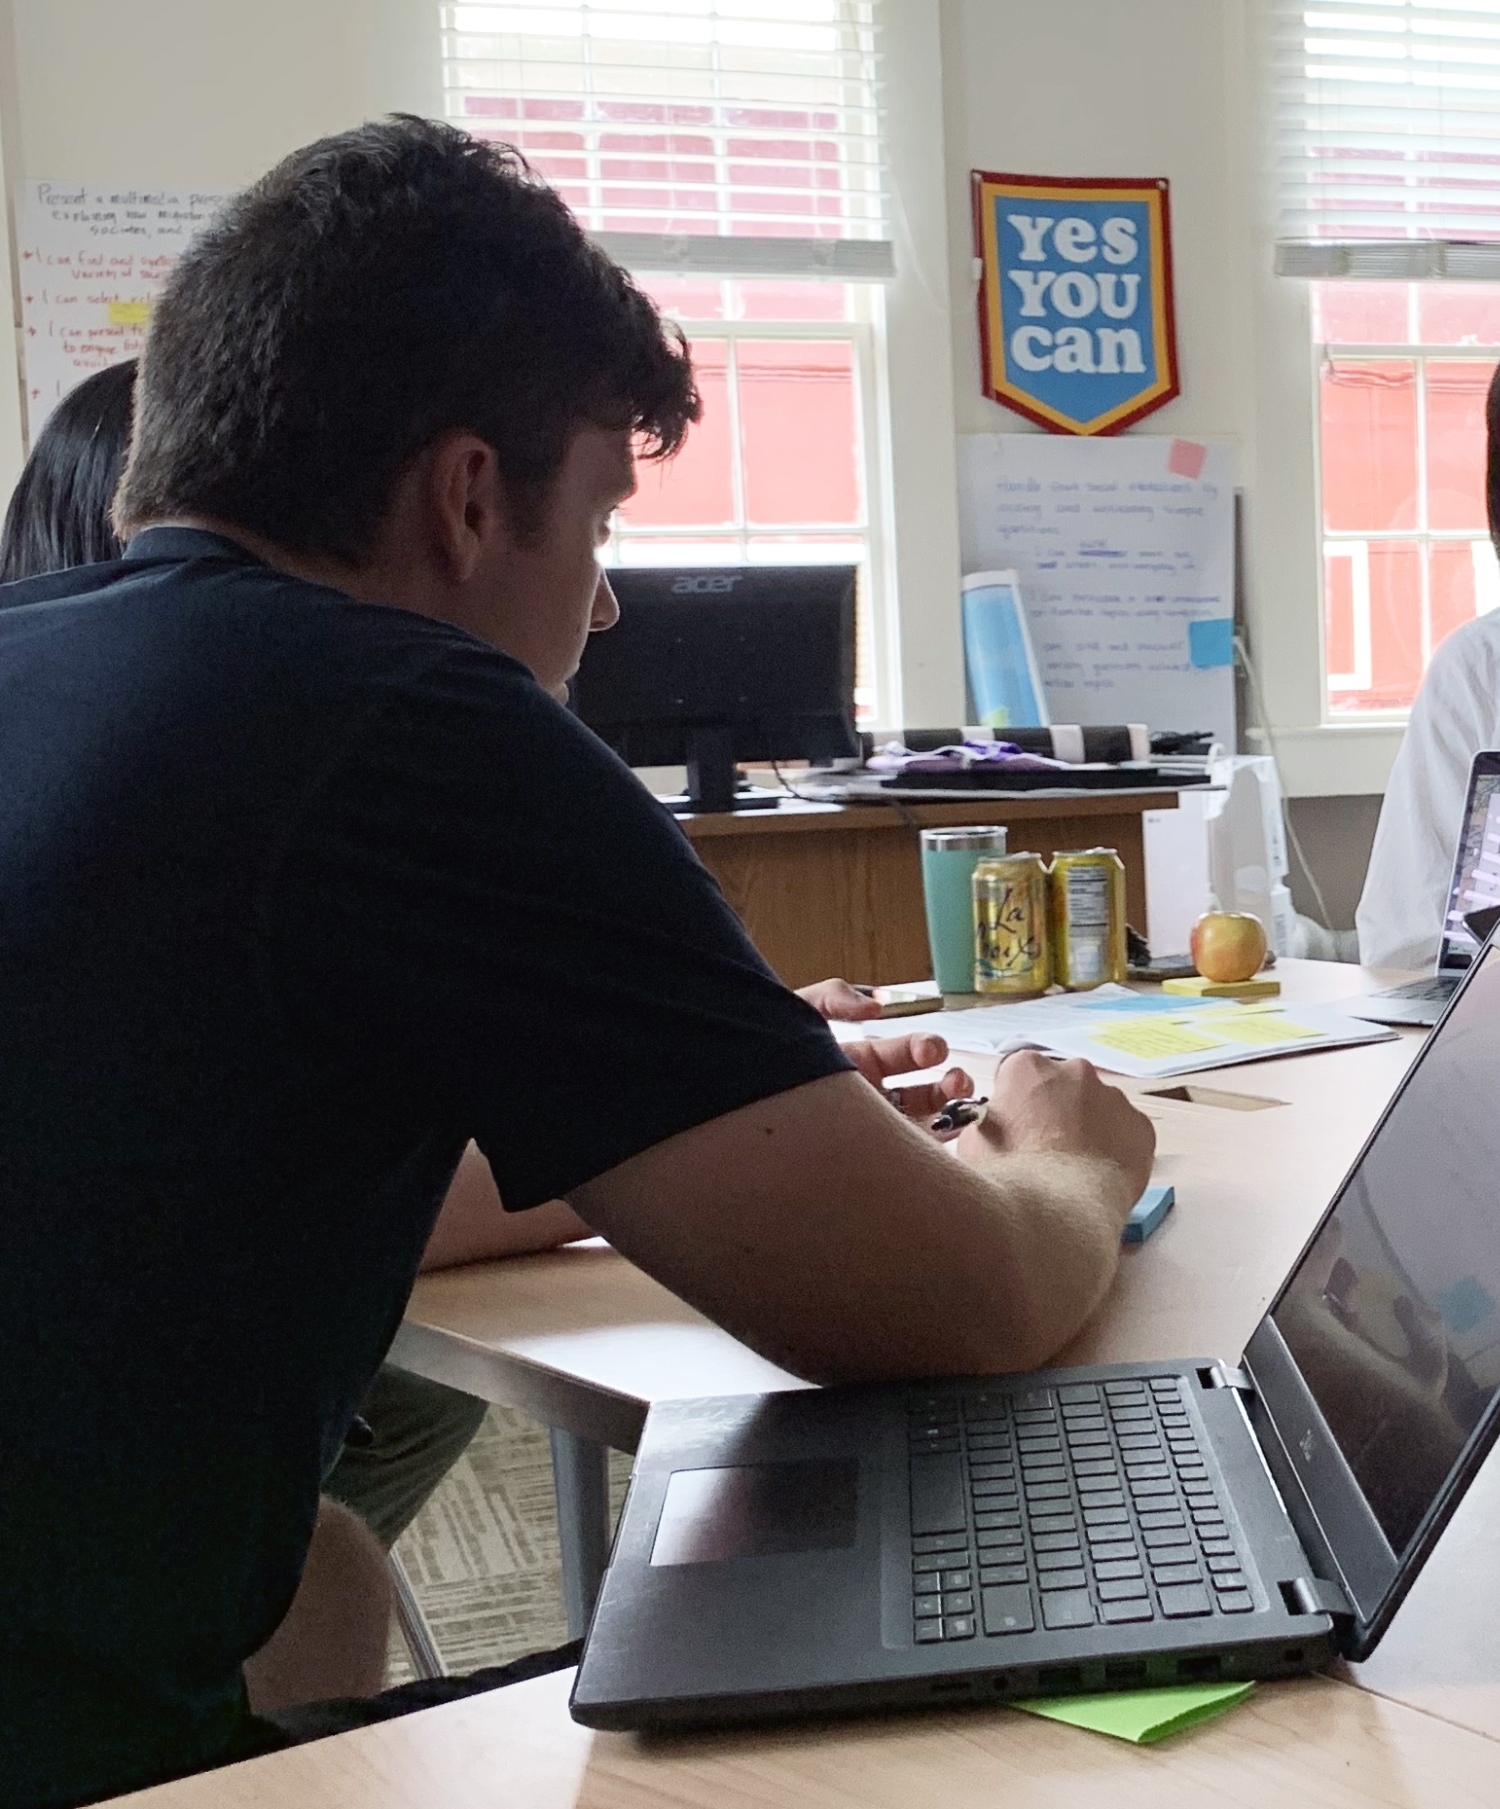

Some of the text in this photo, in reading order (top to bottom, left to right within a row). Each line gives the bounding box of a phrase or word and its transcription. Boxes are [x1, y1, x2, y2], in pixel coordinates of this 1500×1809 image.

[37, 183, 87, 205] Present
[110, 190, 179, 206] multimedia
[47, 253, 72, 266] can
[78, 249, 104, 266] find
[109, 253, 134, 266] and
[56, 294, 79, 304] can
[86, 290, 121, 305] select
[1007, 269, 1142, 320] YOU
[60, 326, 83, 337] can
[63, 340, 77, 354] to
[670, 574, 744, 595] acer
